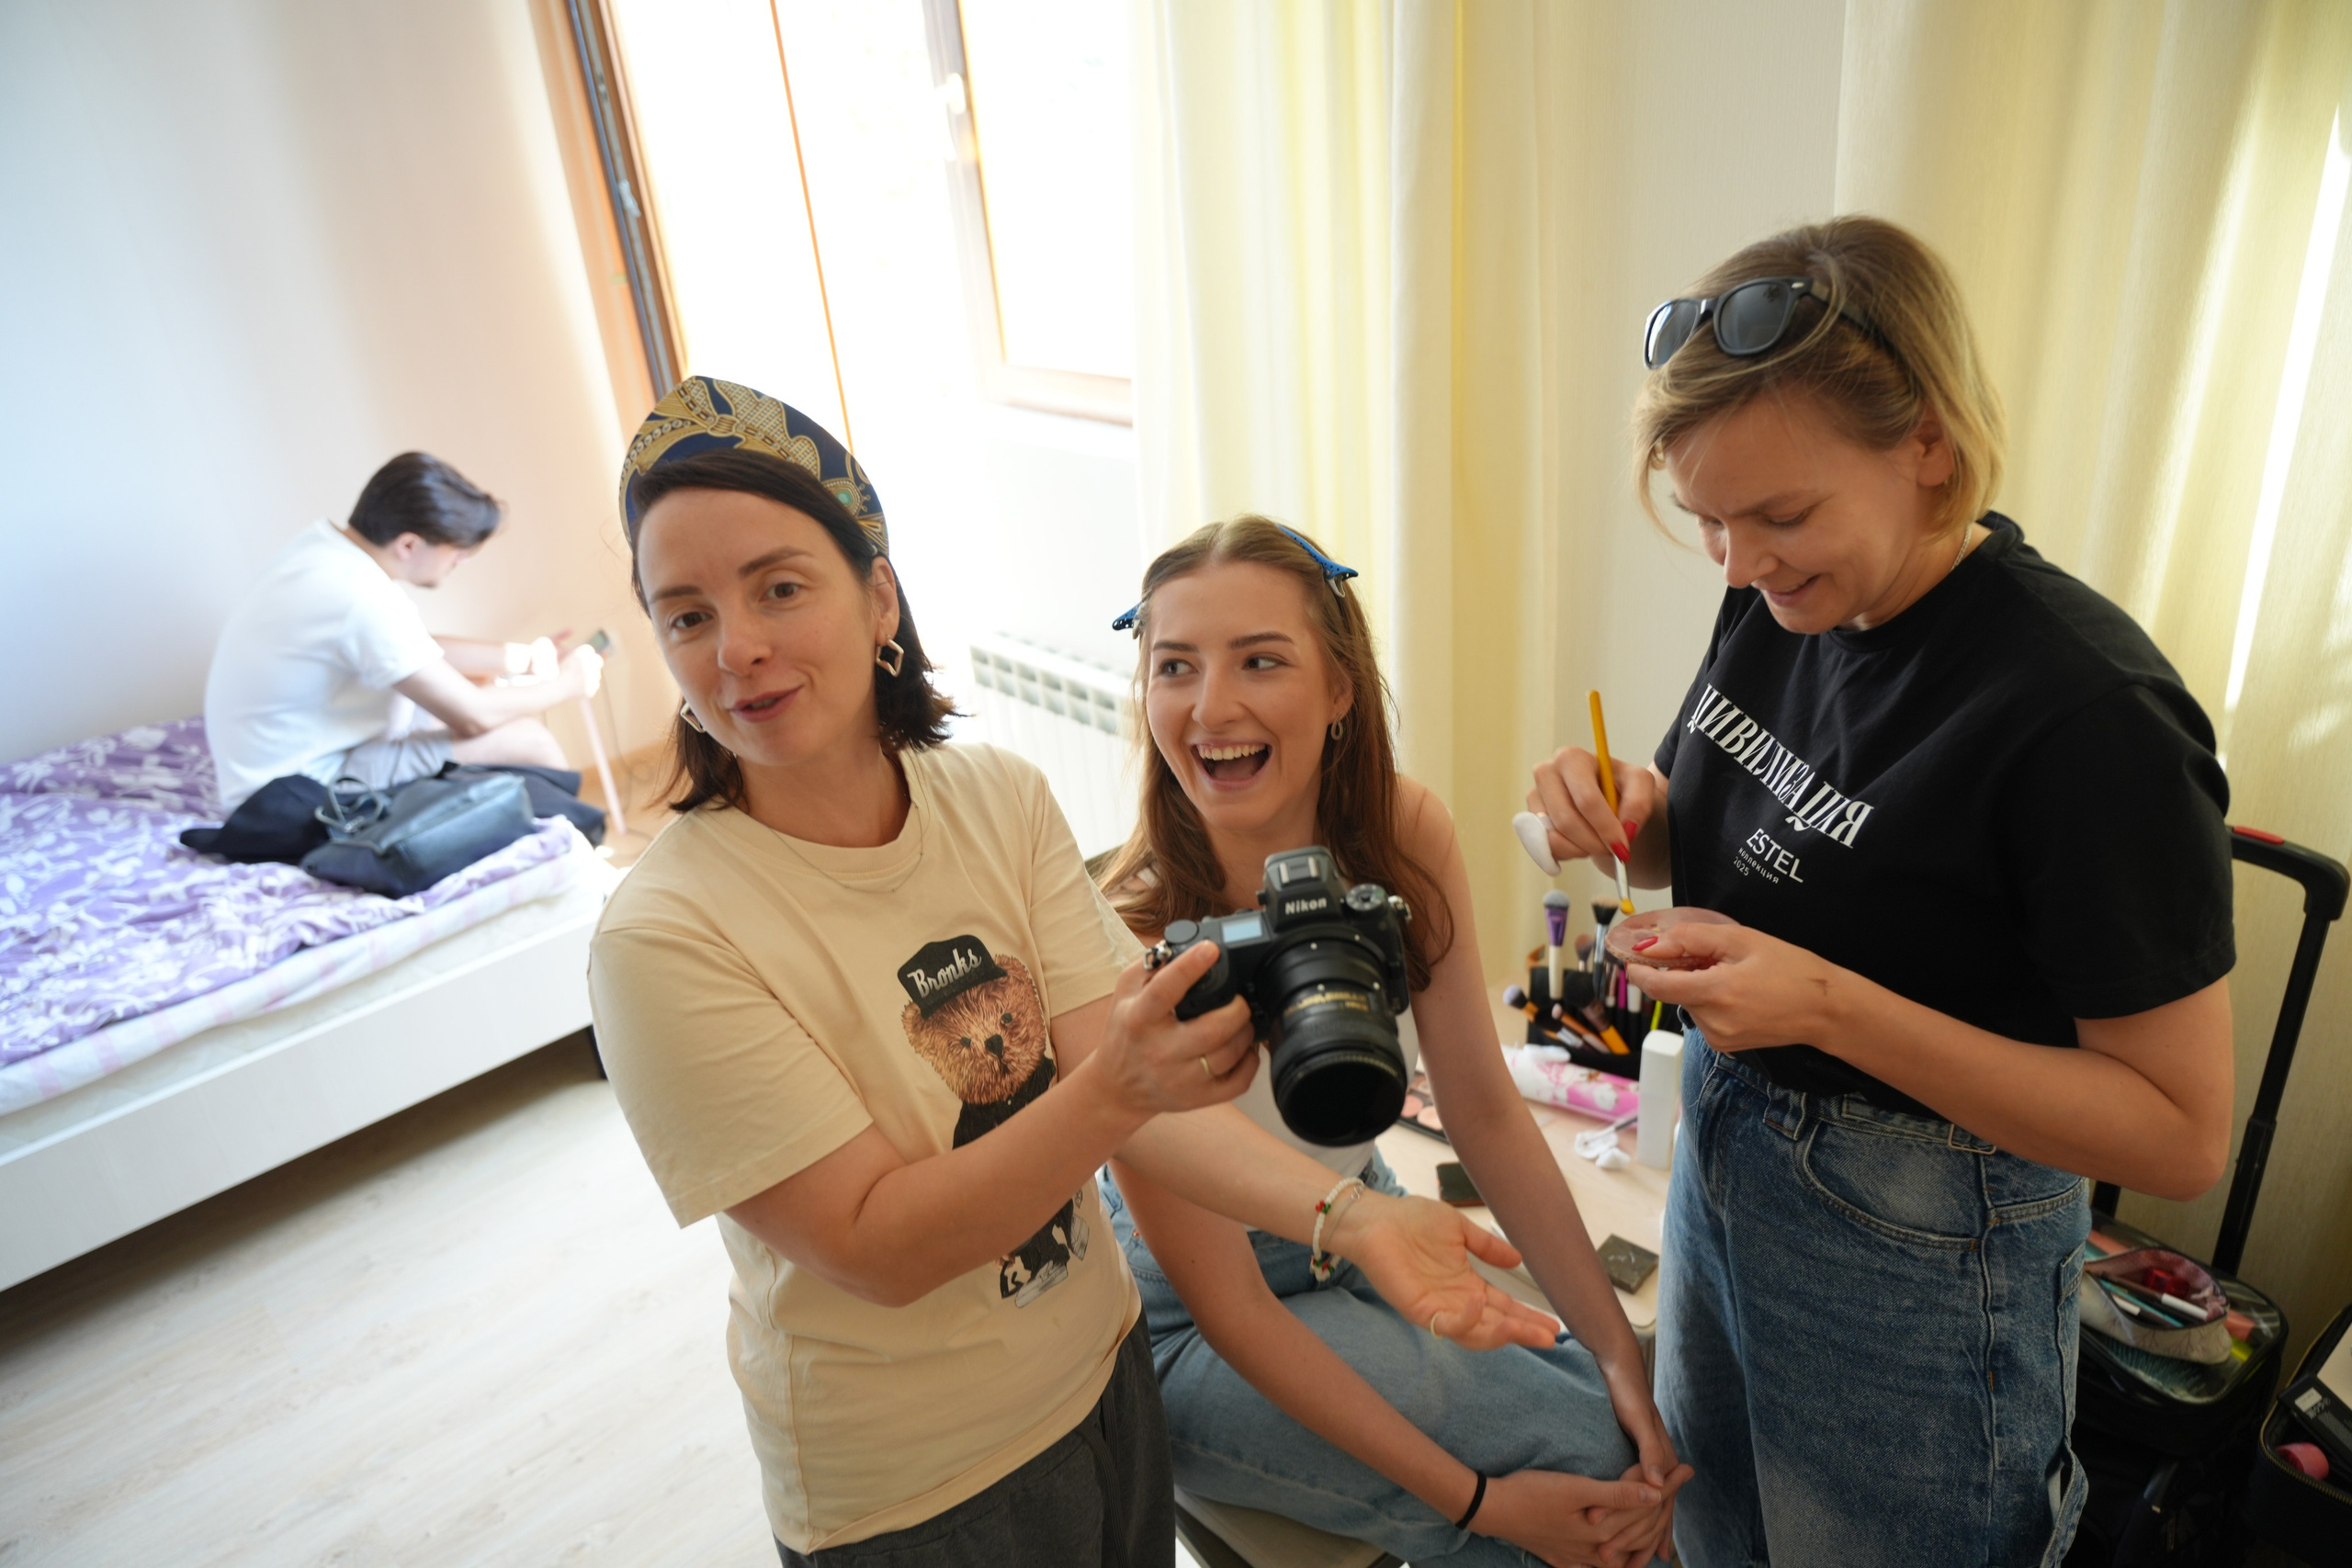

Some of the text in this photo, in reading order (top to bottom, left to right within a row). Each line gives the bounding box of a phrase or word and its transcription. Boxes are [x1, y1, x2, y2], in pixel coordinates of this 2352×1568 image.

[1687, 683, 1874, 849] ЦИВИЛИЗАЦИЯ
[1733, 856, 1749, 876] 2025
[1746, 828, 1804, 883] ESTEL
[1284, 897, 1328, 915] Nikon
[907, 948, 982, 998] Bronks
